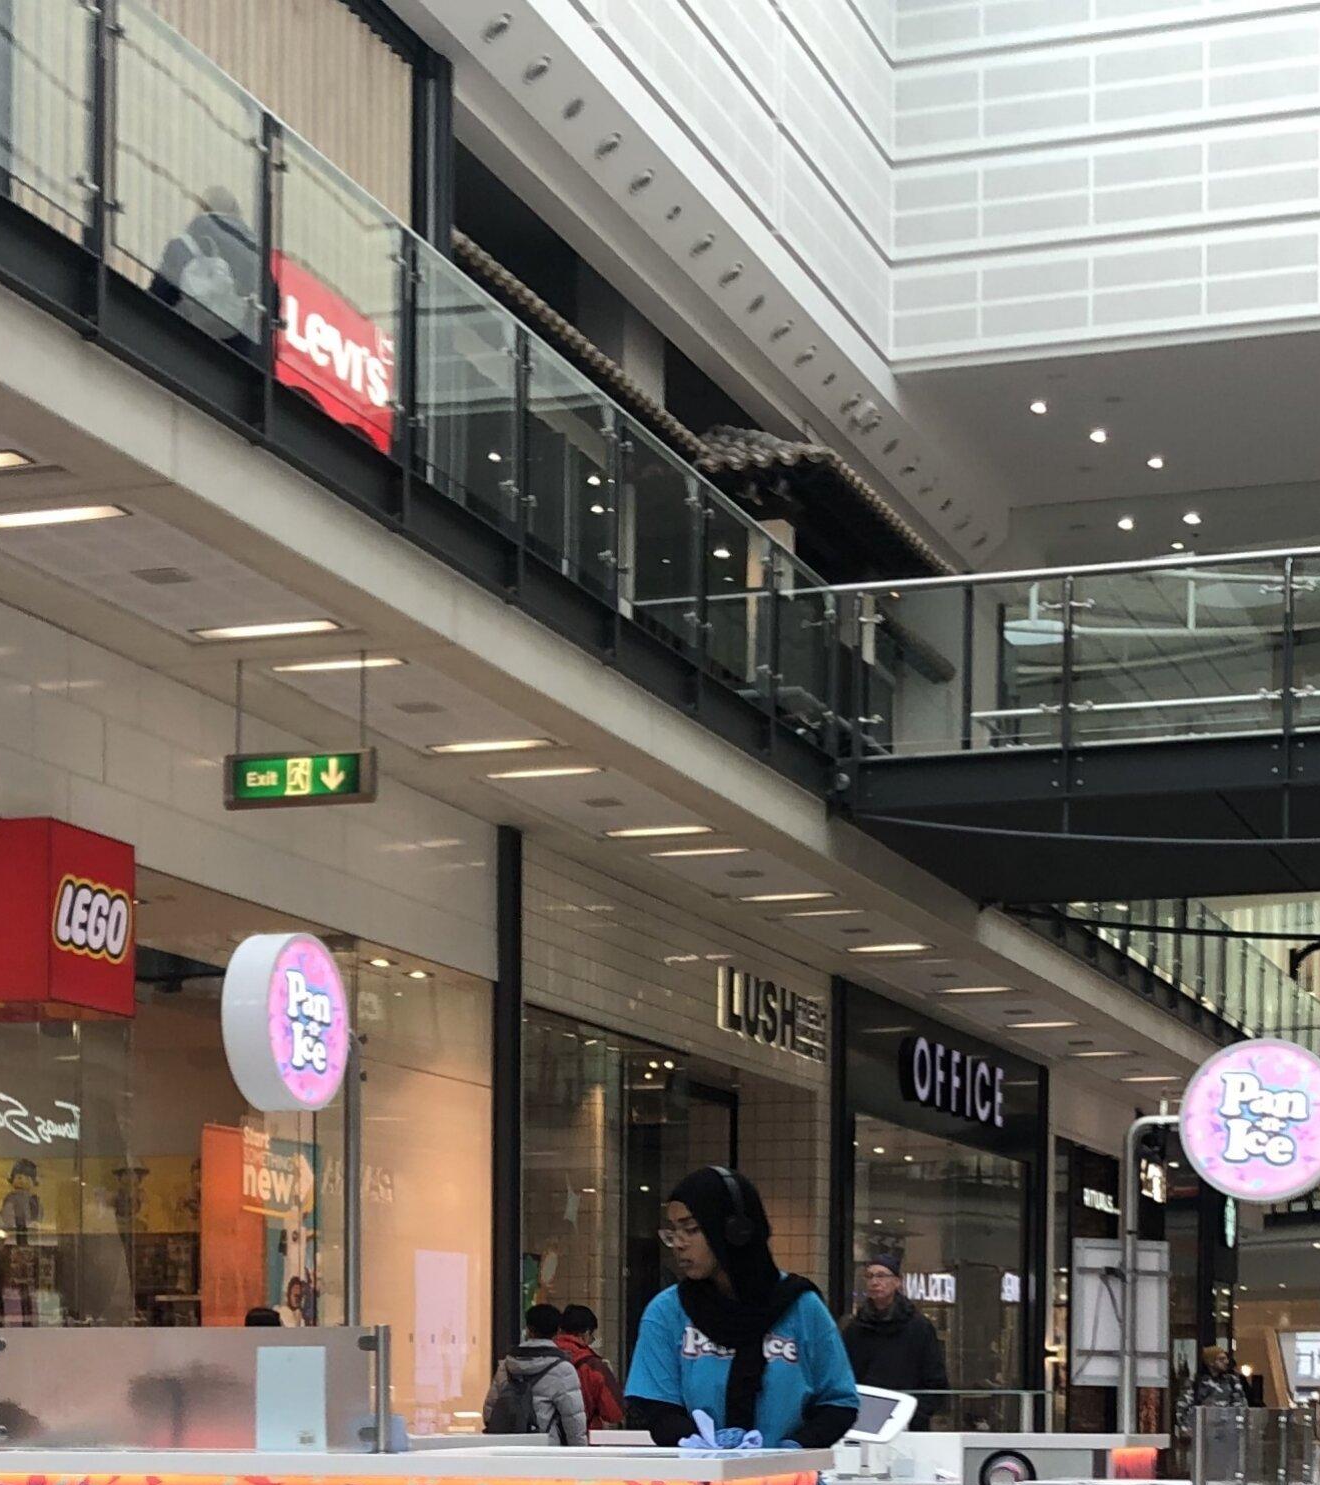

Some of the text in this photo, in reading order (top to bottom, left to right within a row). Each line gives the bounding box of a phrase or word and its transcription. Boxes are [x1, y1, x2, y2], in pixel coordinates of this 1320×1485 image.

[246, 771, 278, 787] Exit
[57, 882, 128, 956] LEGO
[285, 969, 331, 1025] Pan
[719, 966, 795, 1050] LUSH
[291, 1021, 327, 1072] Ice
[913, 1037, 1004, 1128] OFFICE
[1220, 1072, 1309, 1122] Pan
[1223, 1118, 1295, 1166] Ice
[243, 1163, 294, 1204] new
